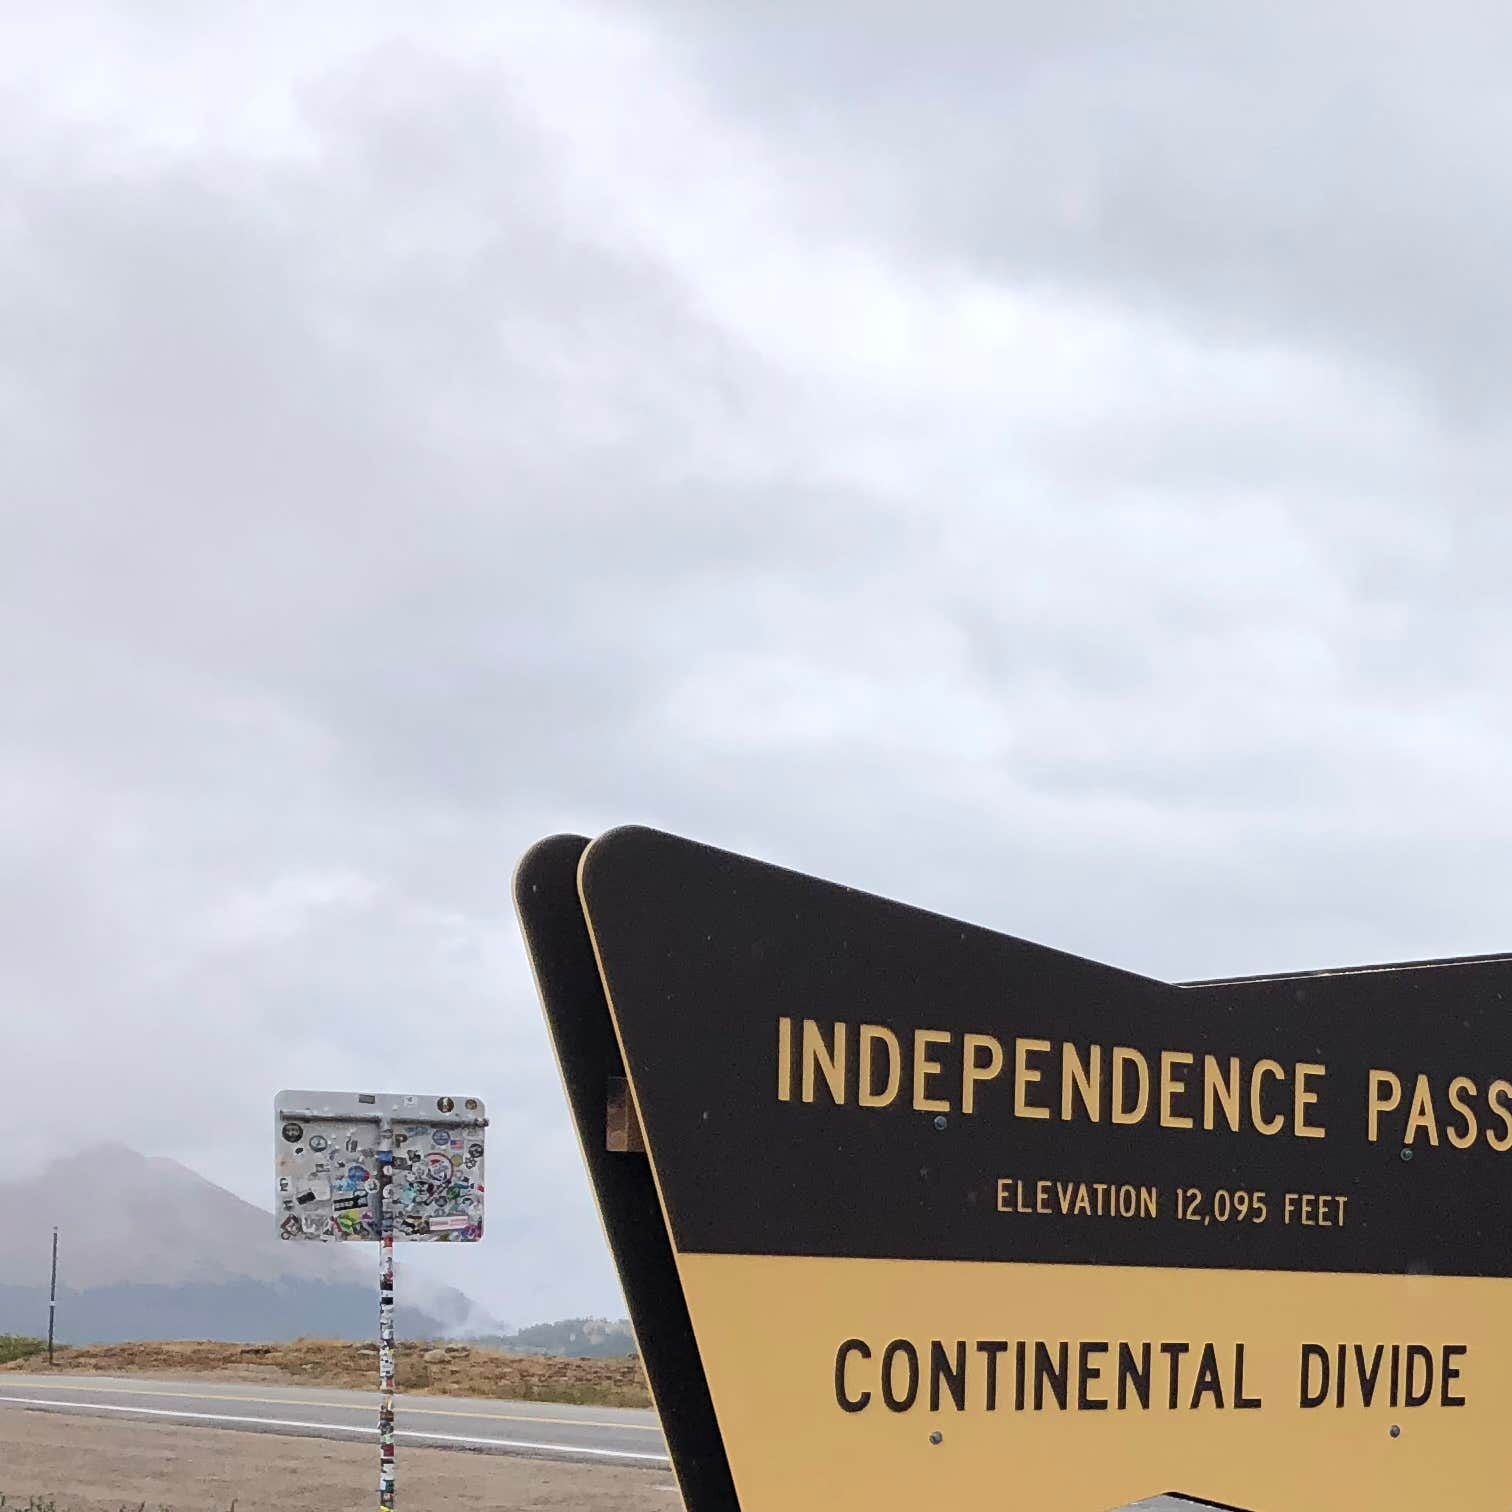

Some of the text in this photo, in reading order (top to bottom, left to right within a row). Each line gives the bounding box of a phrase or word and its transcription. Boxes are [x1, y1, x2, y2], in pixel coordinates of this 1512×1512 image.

[779, 1018, 1325, 1137] INDEPENDENCE
[998, 1179, 1347, 1226] ELEVATION 12,095 FEET
[835, 1339, 1467, 1413] CONTINENTAL DIVIDE
